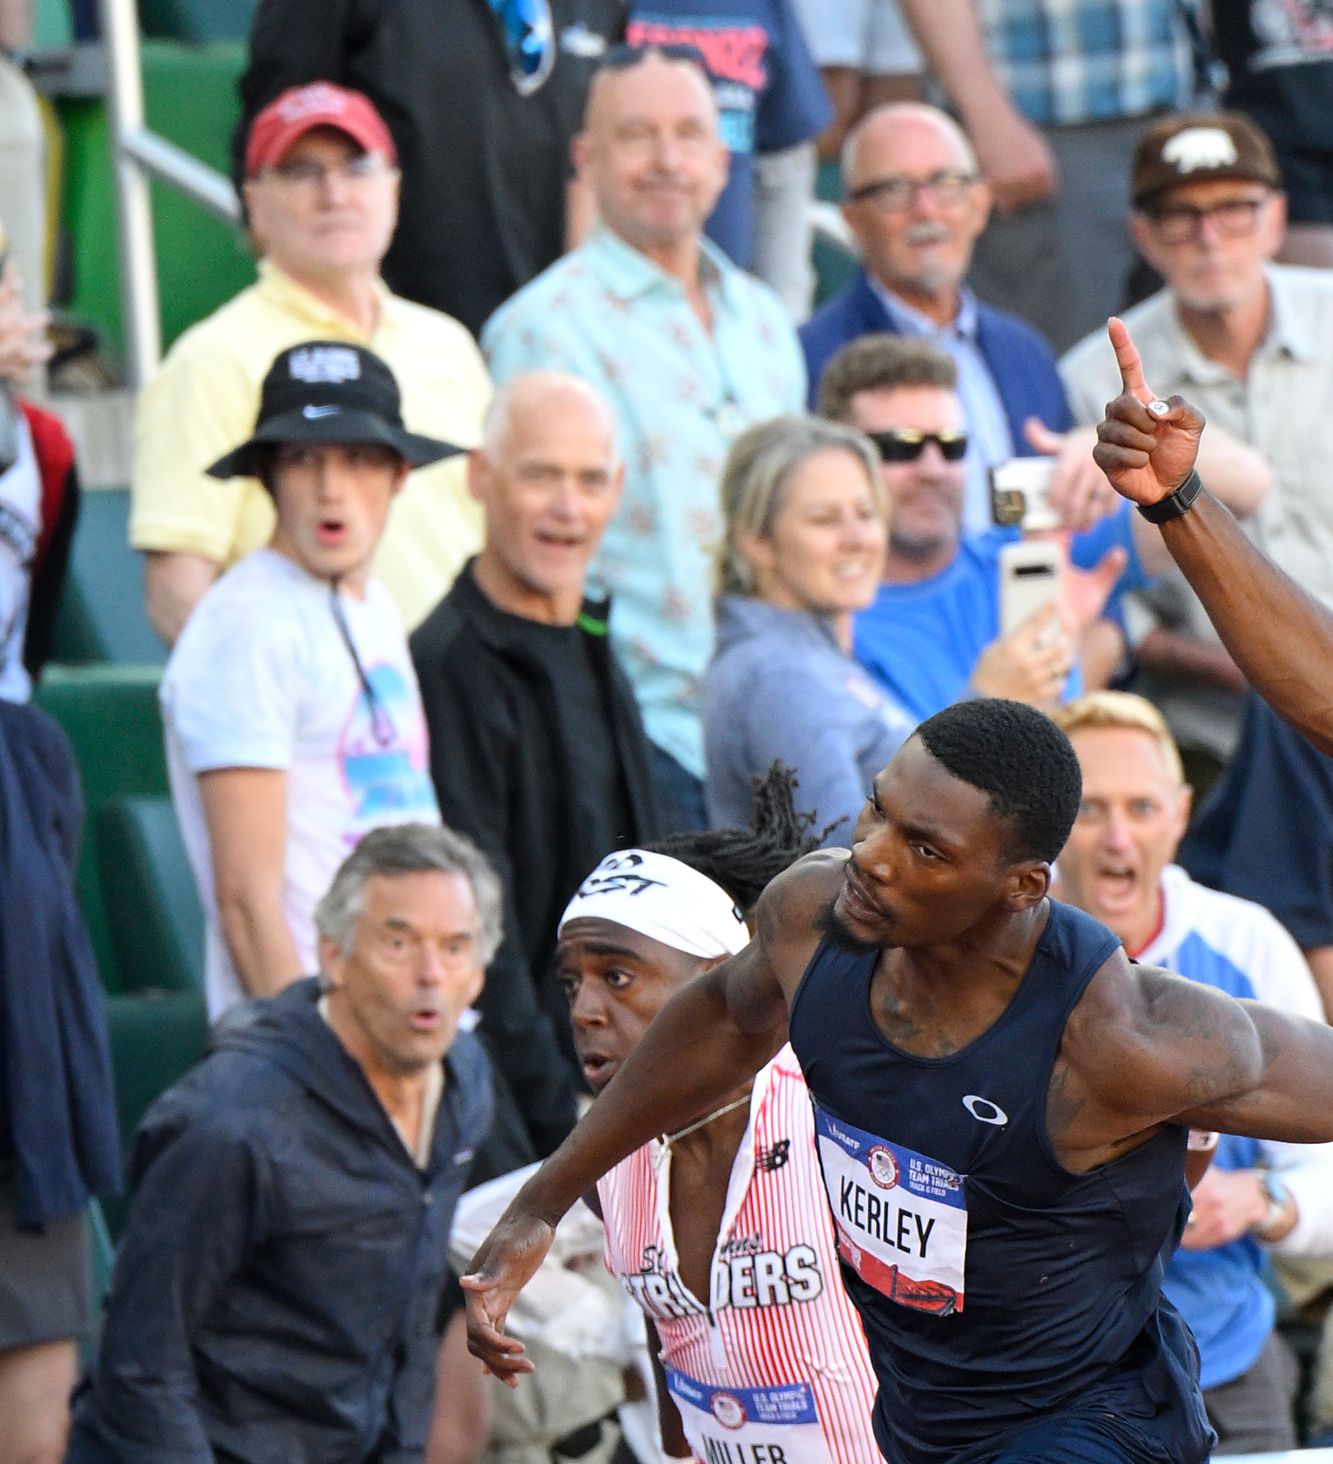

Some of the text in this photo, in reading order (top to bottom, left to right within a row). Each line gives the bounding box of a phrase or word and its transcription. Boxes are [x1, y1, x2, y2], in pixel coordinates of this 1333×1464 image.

[910, 1158, 923, 1173] U.S.
[909, 1169, 929, 1184] TEAM
[840, 1175, 936, 1259] KERLEY
